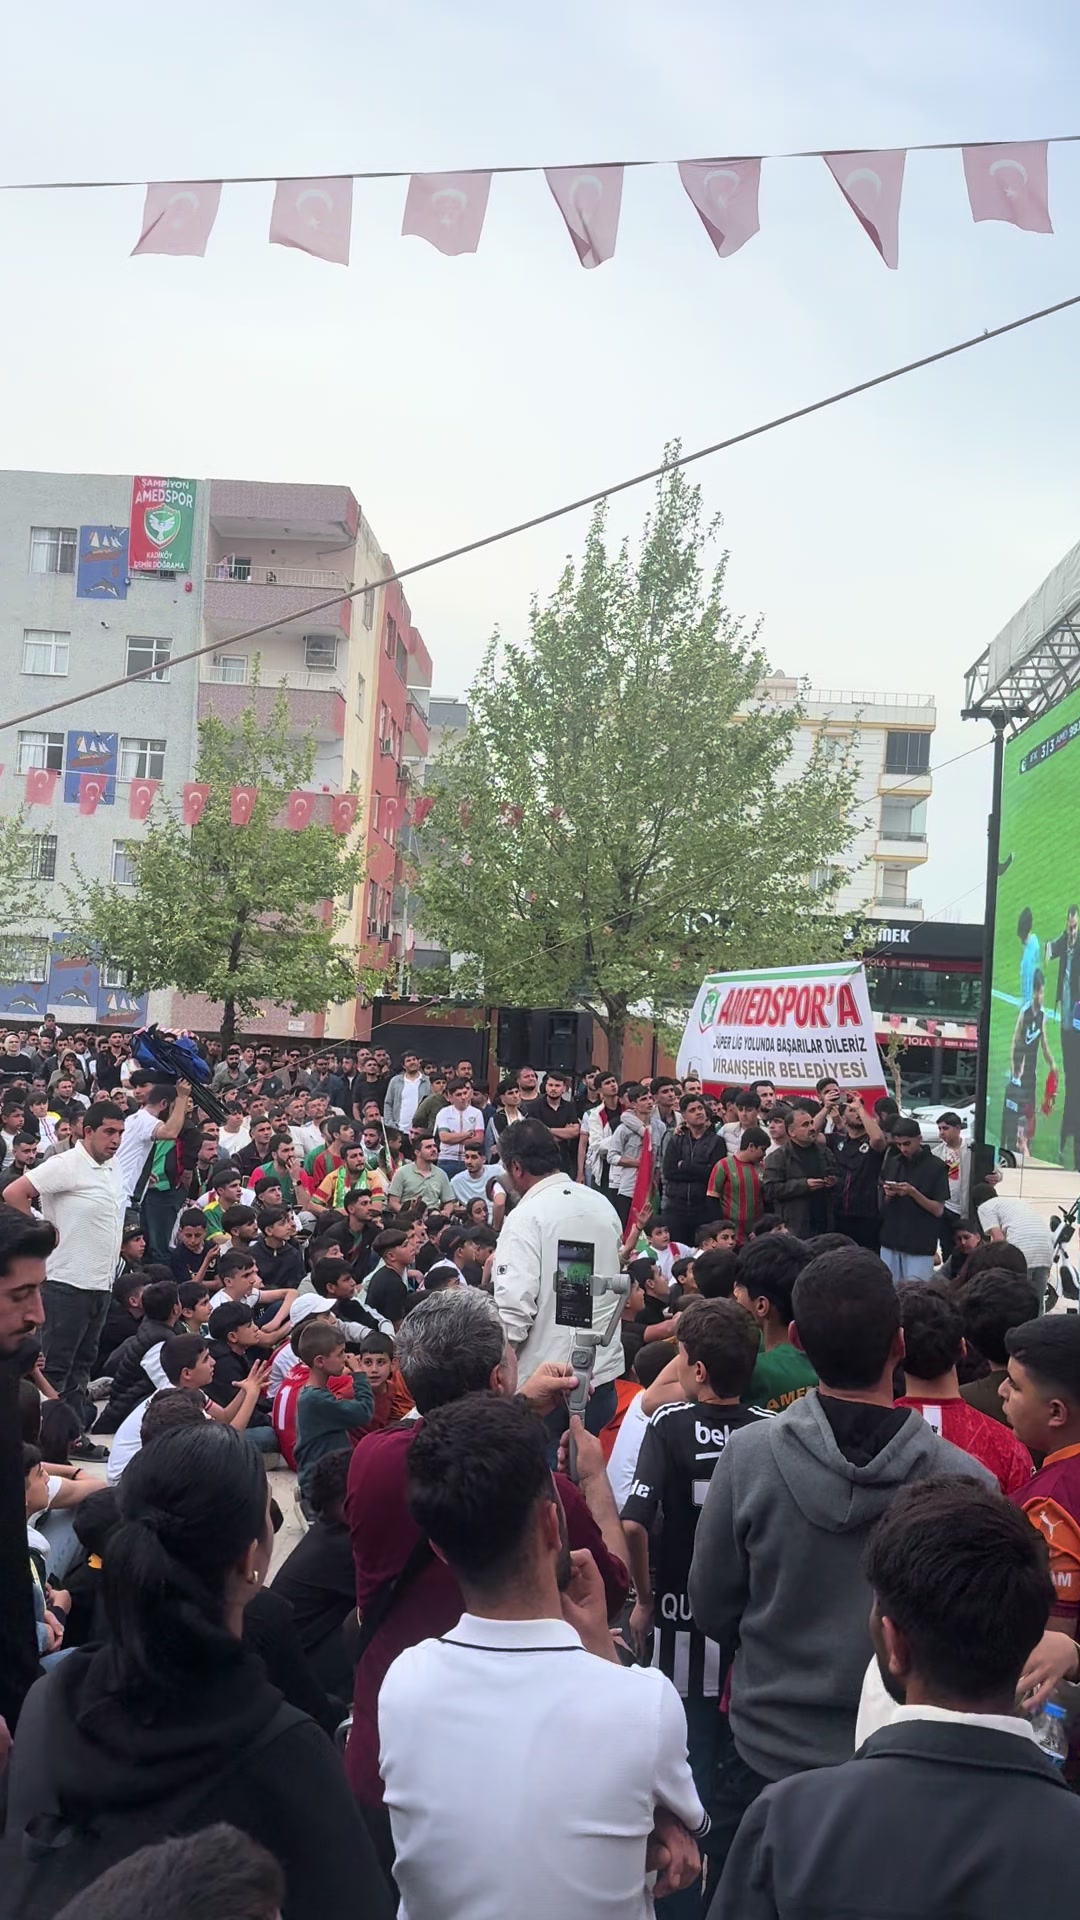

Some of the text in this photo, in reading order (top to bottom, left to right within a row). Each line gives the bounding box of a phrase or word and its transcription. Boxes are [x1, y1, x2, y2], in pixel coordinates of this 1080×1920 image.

[141, 478, 190, 490] ŞAMPİYON
[135, 489, 193, 508] AMEDSPOR
[153, 560, 185, 570] DOĞRAMA
[717, 982, 863, 1027] AMEDSPOR'A
[732, 1033, 743, 1051] LİG
[744, 1036, 775, 1052] YOLUNDA
[777, 1037, 824, 1057] BAŞARILAR
[825, 1034, 868, 1054] DİLERİZ
[713, 1056, 868, 1079] VİRANŞEHİR BELEDİYESİ
[766, 1386, 812, 1411] AME
